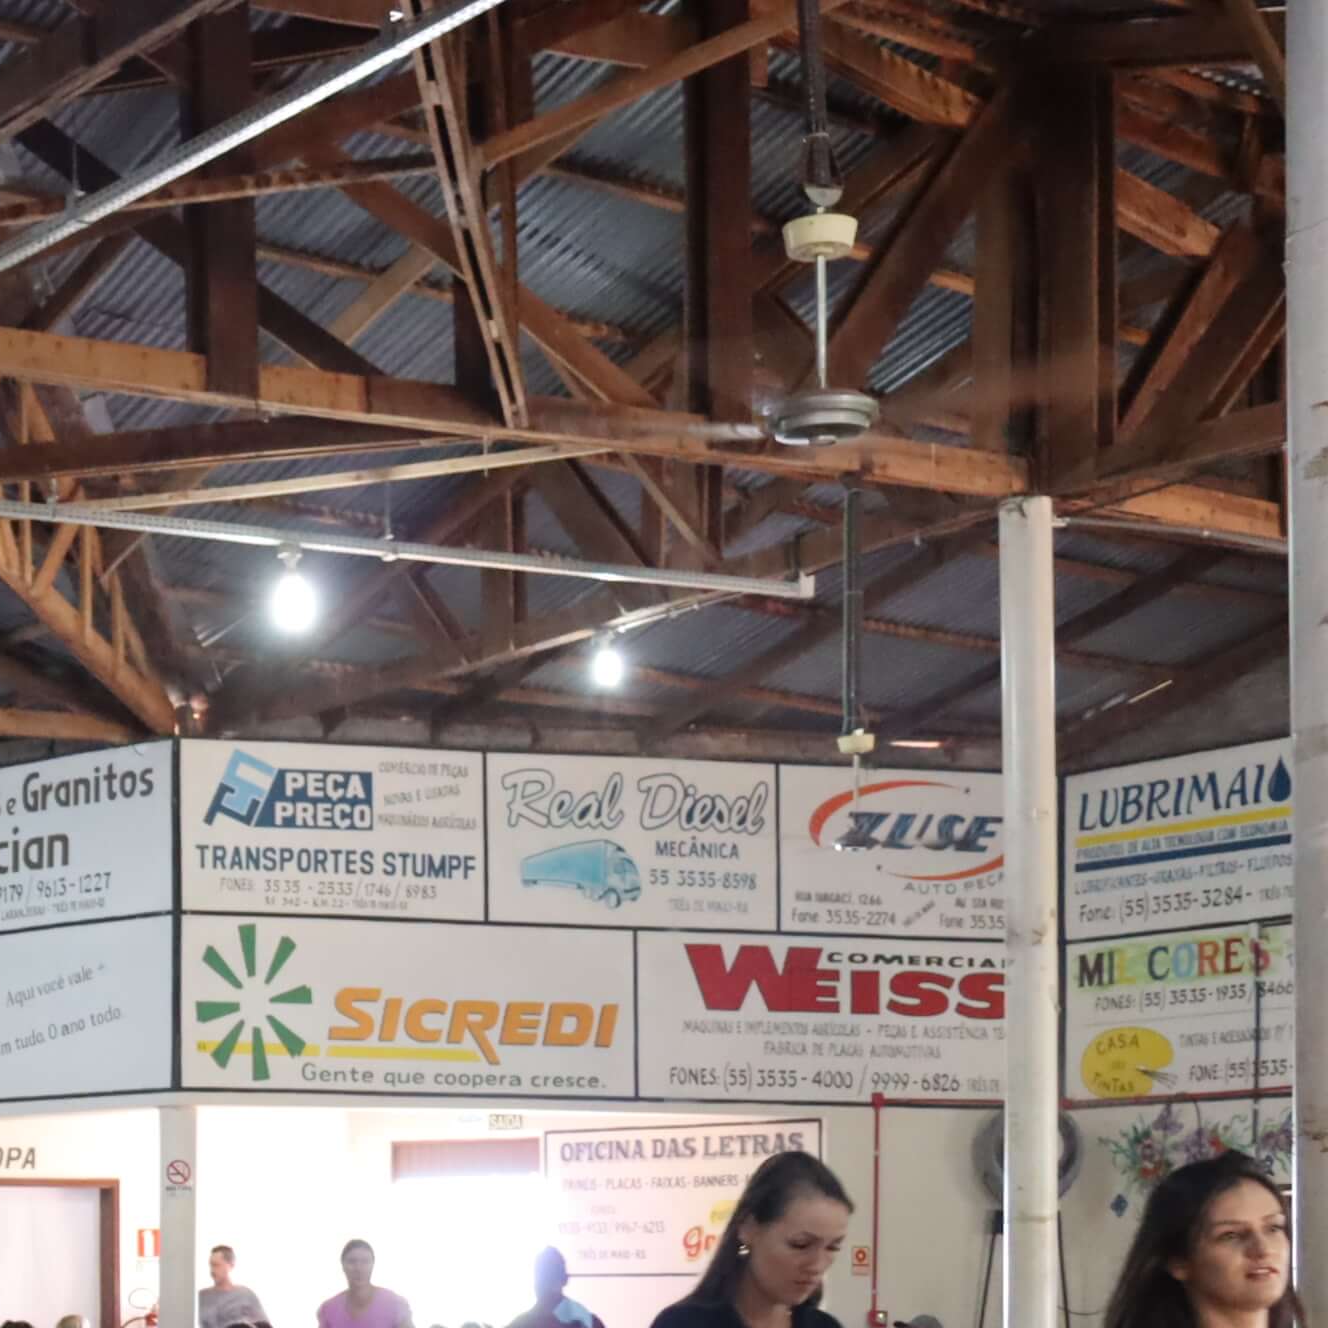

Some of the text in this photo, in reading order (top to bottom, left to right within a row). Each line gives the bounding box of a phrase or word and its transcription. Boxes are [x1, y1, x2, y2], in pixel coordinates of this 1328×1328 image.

[5, 798, 18, 817] e
[22, 763, 155, 815] Granitos
[284, 771, 367, 802] PEÇA
[500, 767, 770, 837] Real Diesel
[194, 844, 478, 881] TRANSPORTES STUMPF
[654, 835, 741, 860] MECÂNICA
[263, 878, 302, 895] 3535
[648, 868, 671, 886] 55
[903, 880, 958, 896] AUTO
[791, 910, 820, 926] Fone
[825, 910, 897, 928] 3535-2274
[1077, 936, 1272, 988] MIL CORES
[5, 985, 36, 1009] Aqui
[67, 965, 94, 988] vale
[684, 943, 1005, 1019] WEISS
[60, 1017, 87, 1037] ano
[327, 986, 620, 1066] SICREDI
[1095, 1033, 1141, 1056] CASA
[300, 1061, 375, 1085] Gente
[382, 1067, 426, 1087] que
[433, 1071, 523, 1091] coopera
[560, 1131, 805, 1163] OFICINA DAS LETRAS
[604, 1176, 642, 1191] PLACAS
[693, 1174, 740, 1188] BANNERS
